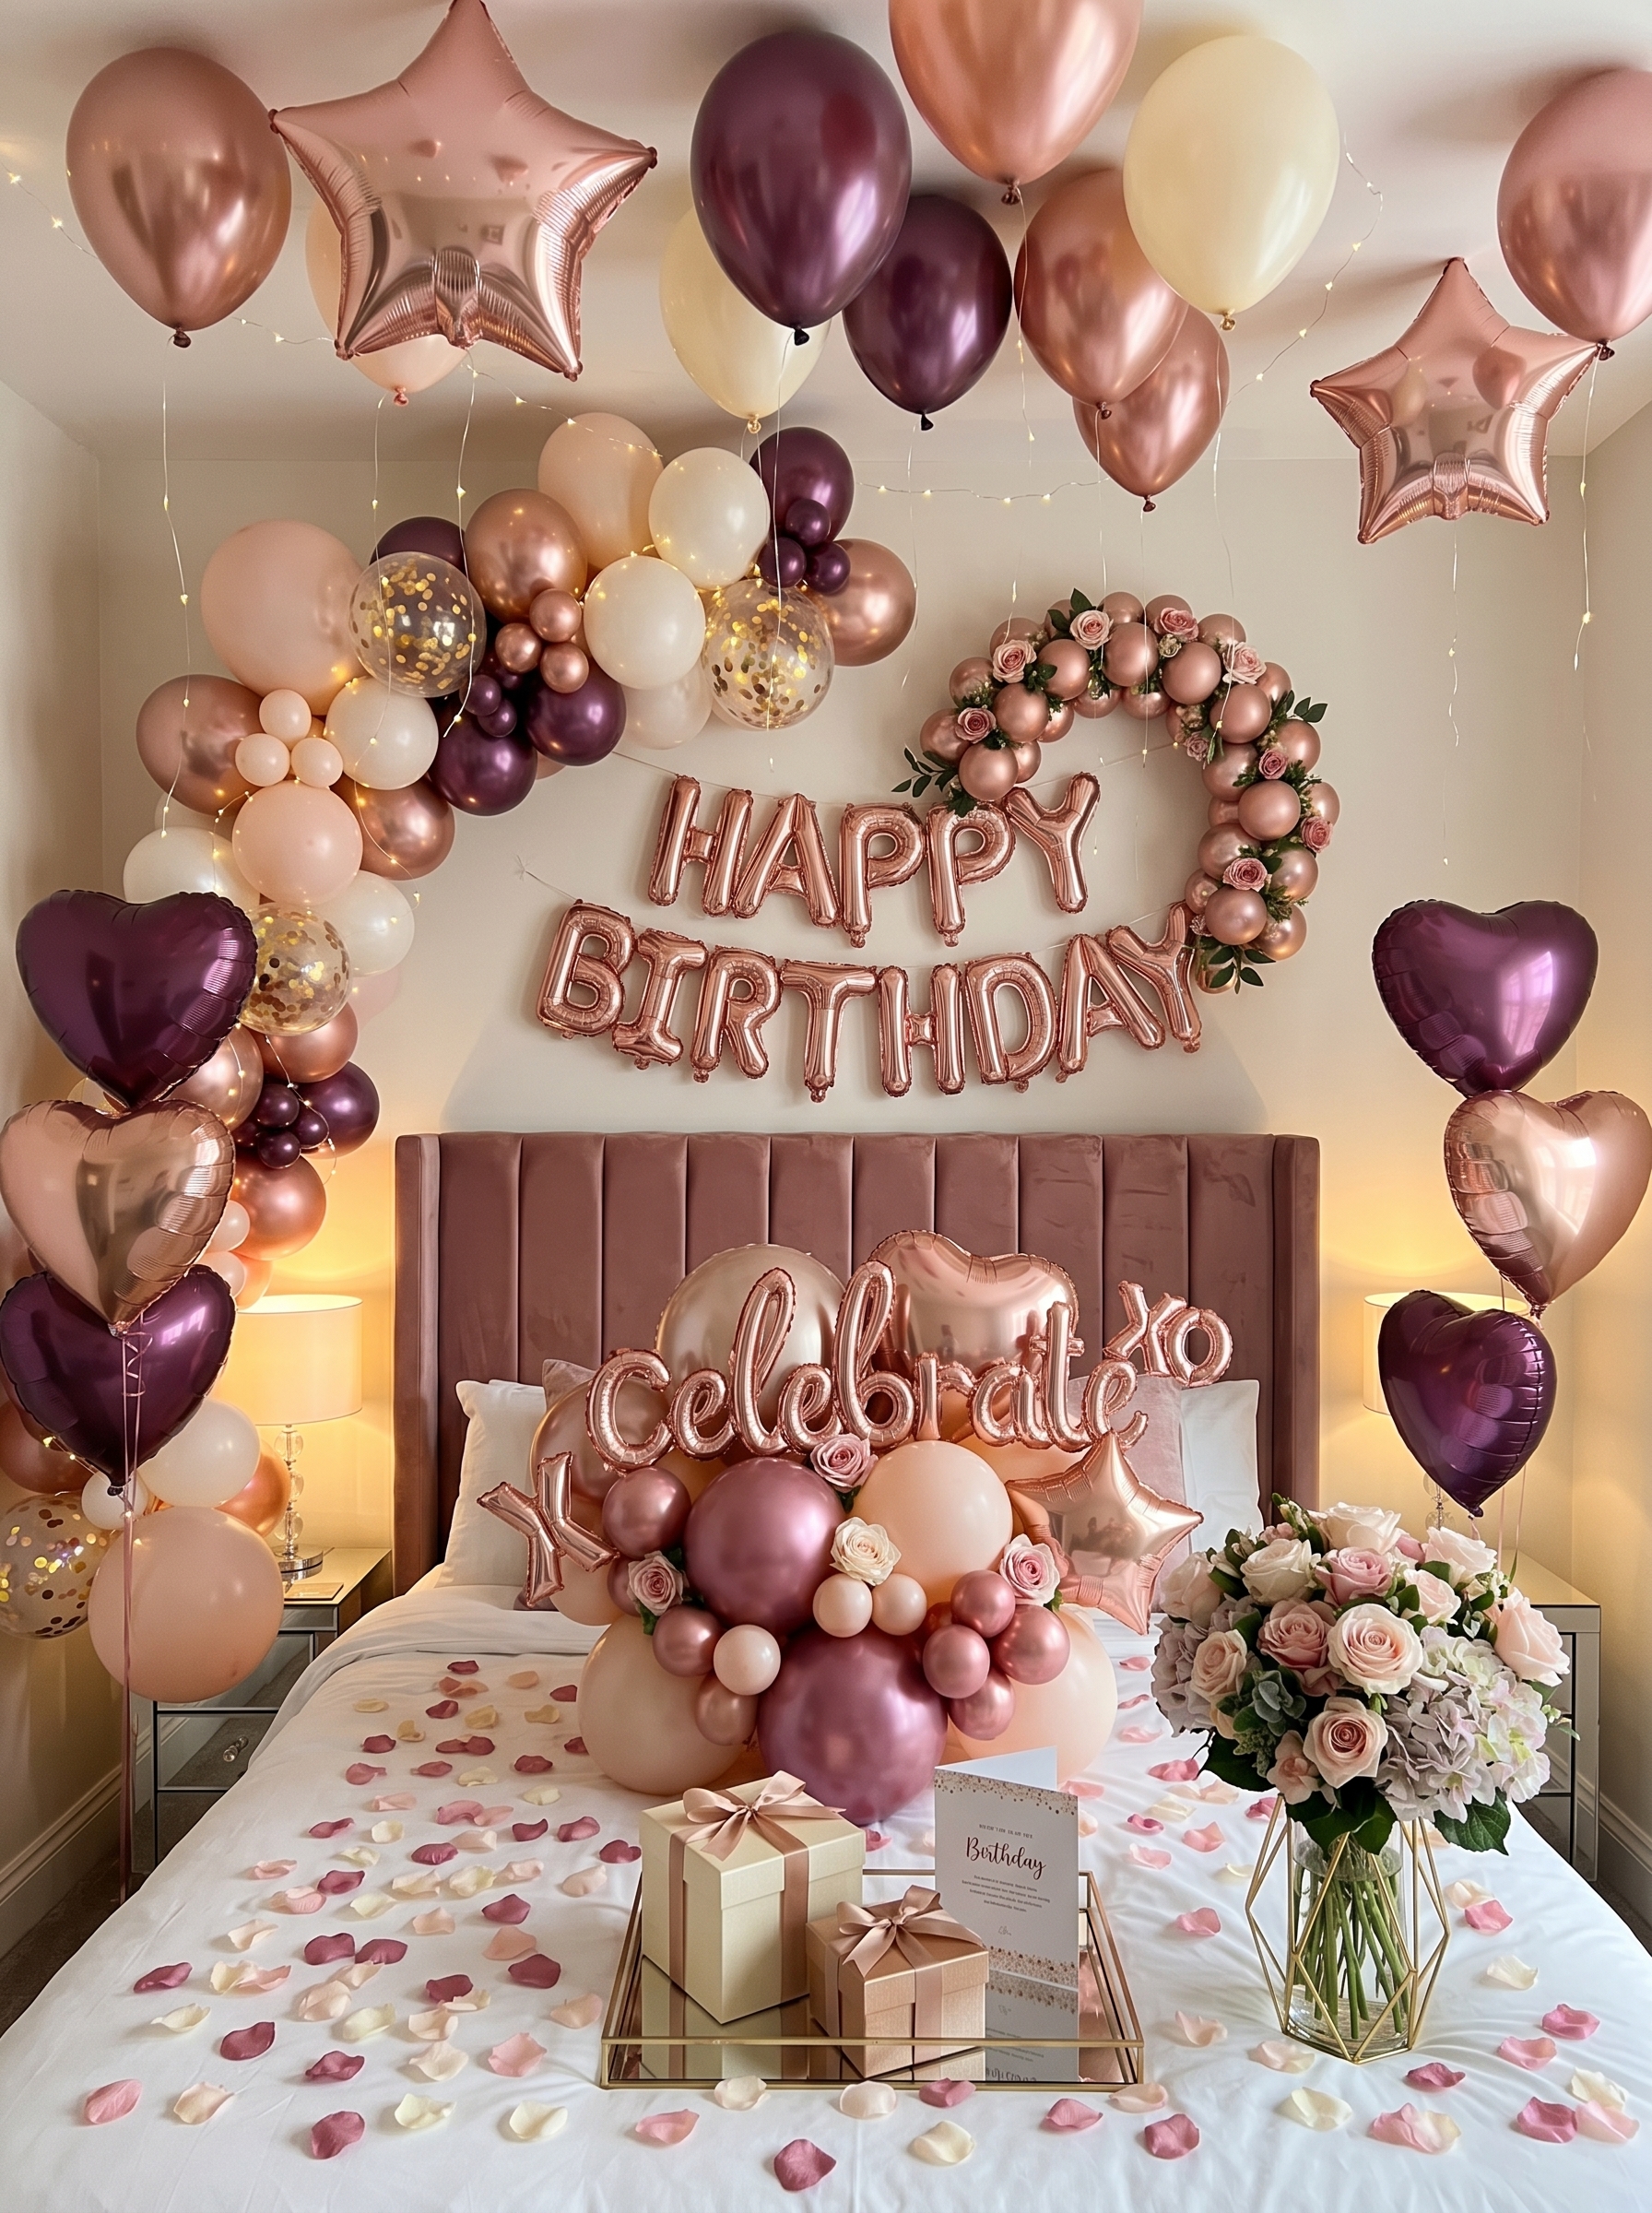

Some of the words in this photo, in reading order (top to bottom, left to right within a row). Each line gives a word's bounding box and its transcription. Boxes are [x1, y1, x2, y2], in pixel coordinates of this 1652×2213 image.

[648, 772, 1101, 947] HAPPY
[537, 899, 1202, 1103] BIRTHDAY
[966, 1836, 1047, 1881] Birthday
